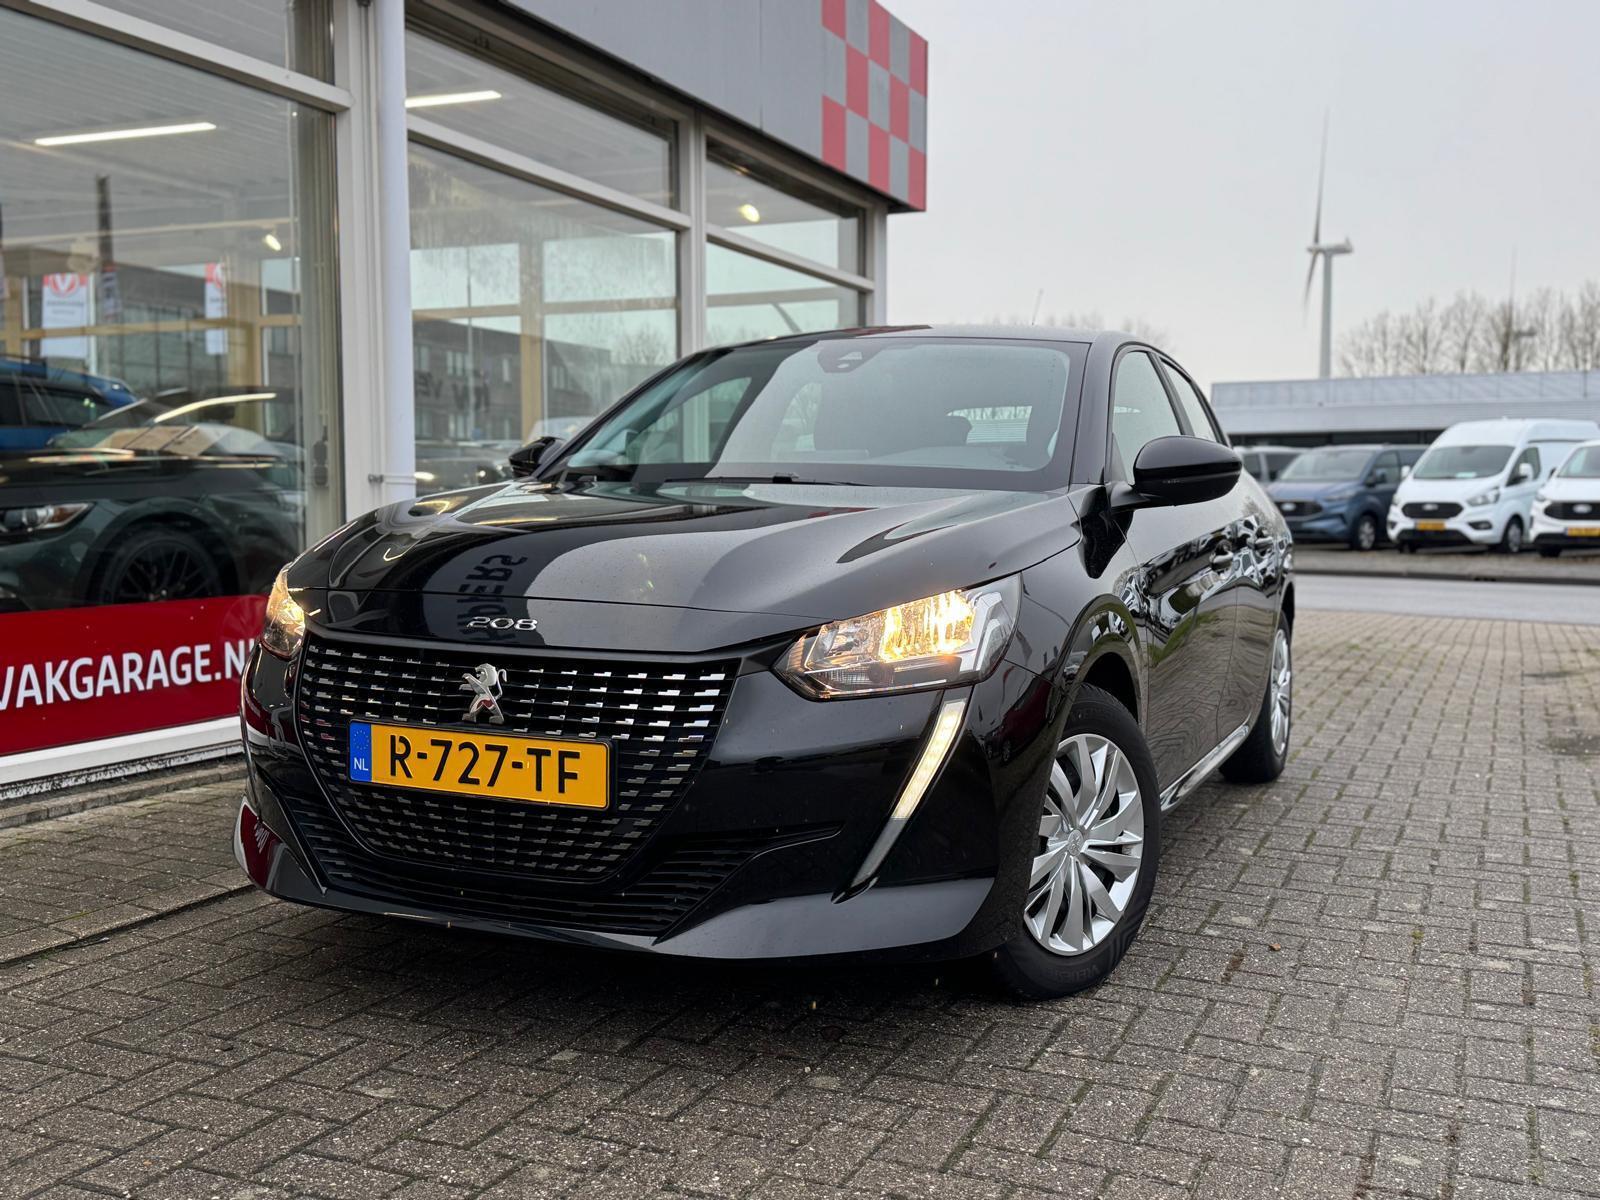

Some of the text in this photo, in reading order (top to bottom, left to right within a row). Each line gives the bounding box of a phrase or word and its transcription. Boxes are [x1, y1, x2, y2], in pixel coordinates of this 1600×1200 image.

[466, 616, 538, 631] 208
[353, 756, 369, 771] NL
[389, 734, 581, 794] R-727-TF
